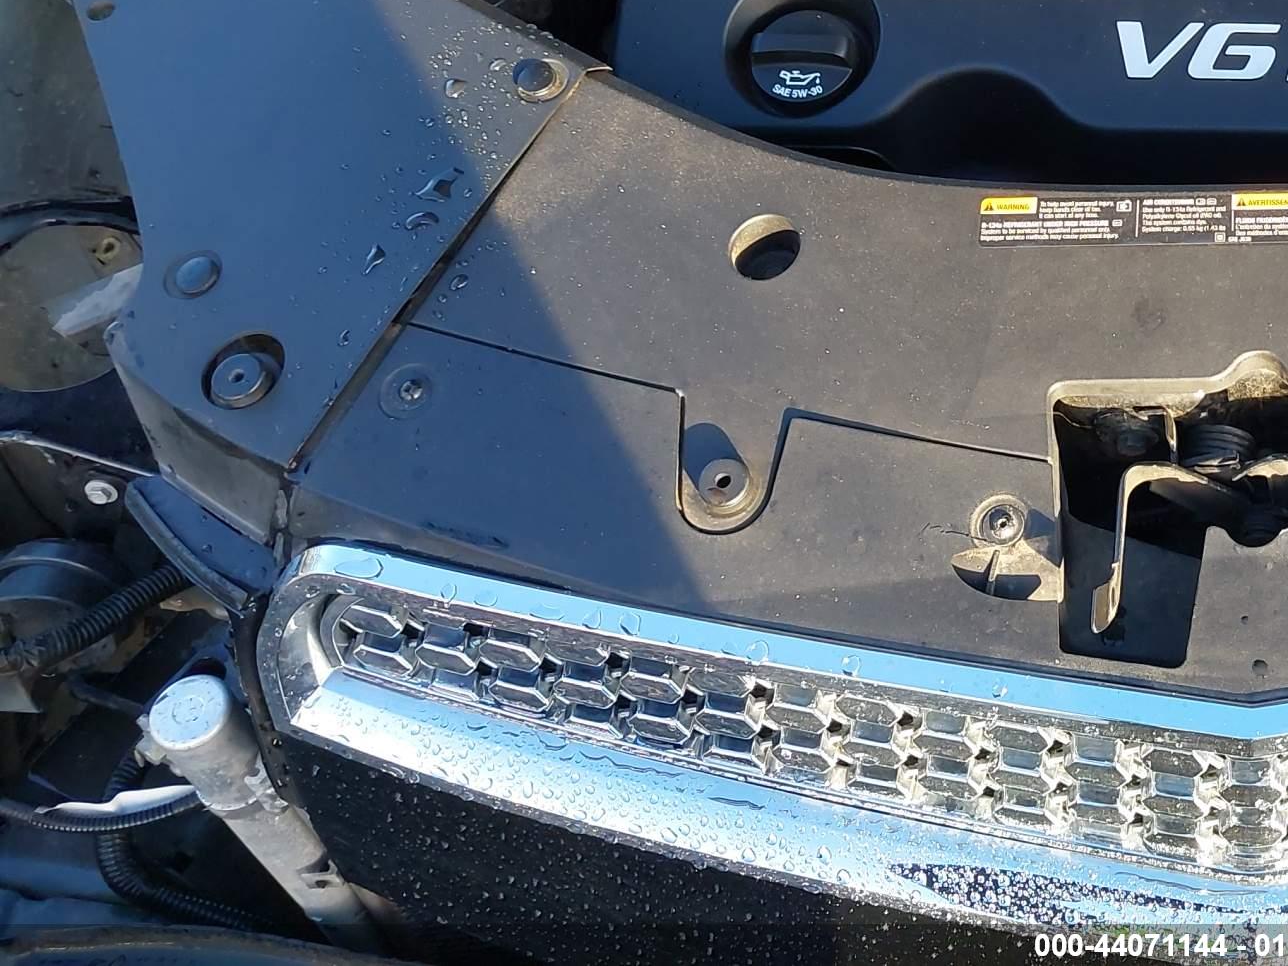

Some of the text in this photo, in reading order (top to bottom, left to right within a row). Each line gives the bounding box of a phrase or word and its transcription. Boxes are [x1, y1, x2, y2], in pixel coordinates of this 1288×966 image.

[1116, 21, 1281, 80] V6
[772, 84, 823, 98] SAE 5W-30
[997, 203, 1030, 211] WARNING
